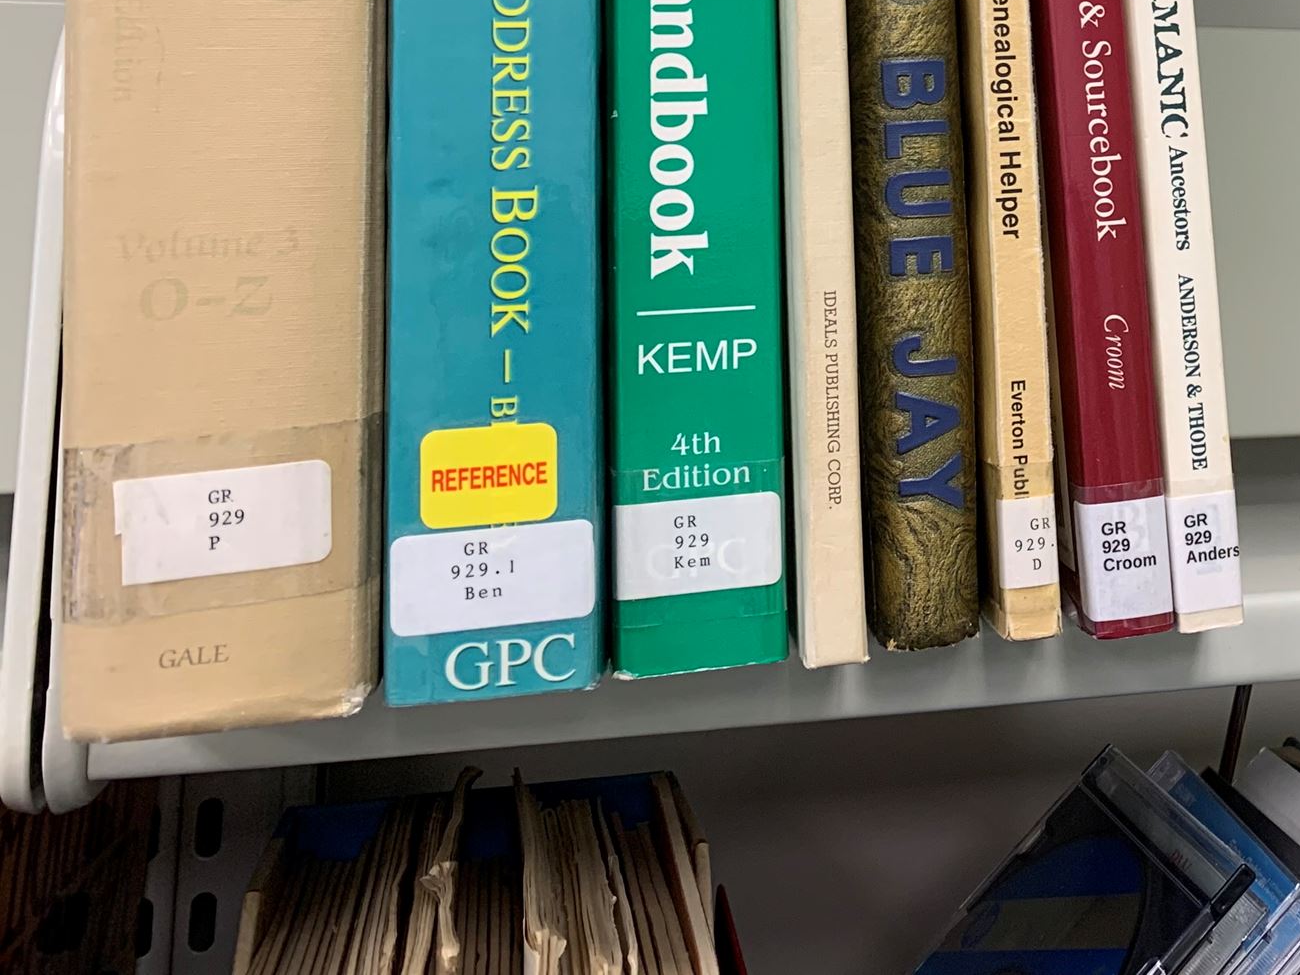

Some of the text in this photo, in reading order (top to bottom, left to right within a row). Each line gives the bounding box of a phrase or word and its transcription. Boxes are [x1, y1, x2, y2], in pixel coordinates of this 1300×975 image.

[1078, 0, 1100, 28] &
[1081, 40, 1127, 241] Sourcebook
[880, 58, 955, 277] BLUE
[996, 150, 1023, 239] Helper
[1168, 146, 1191, 251] Ancestors
[489, 185, 538, 337] BOOK
[1178, 274, 1203, 381] ANDERSON
[637, 338, 758, 375] KEMP
[1103, 315, 1130, 390] Croom
[823, 290, 842, 510] IDEALS PUBLISHING CORP.
[1187, 384, 1204, 398] &
[891, 334, 966, 510] JAY
[671, 432, 721, 455] 4th
[1010, 379, 1029, 500] Everton Publ
[1188, 403, 1208, 471] THODE
[431, 462, 547, 493] REFERENCE
[642, 463, 751, 491] Edition
[208, 489, 233, 505] GR
[209, 509, 245, 528] 929
[674, 515, 697, 529] GR
[1030, 517, 1050, 530] GR
[1101, 521, 1126, 536] GR
[1184, 513, 1208, 528] GR
[209, 536, 221, 550] P
[464, 541, 489, 556] GR
[675, 533, 710, 549] 929
[1102, 538, 1131, 554] 929
[1185, 530, 1212, 546] 929
[674, 555, 712, 570] Kem
[1032, 558, 1042, 570] D
[1103, 553, 1157, 572] Croom
[1187, 546, 1240, 564] Anders
[464, 585, 503, 600] Ben
[158, 644, 229, 669] GALE
[445, 633, 577, 691] GPC
